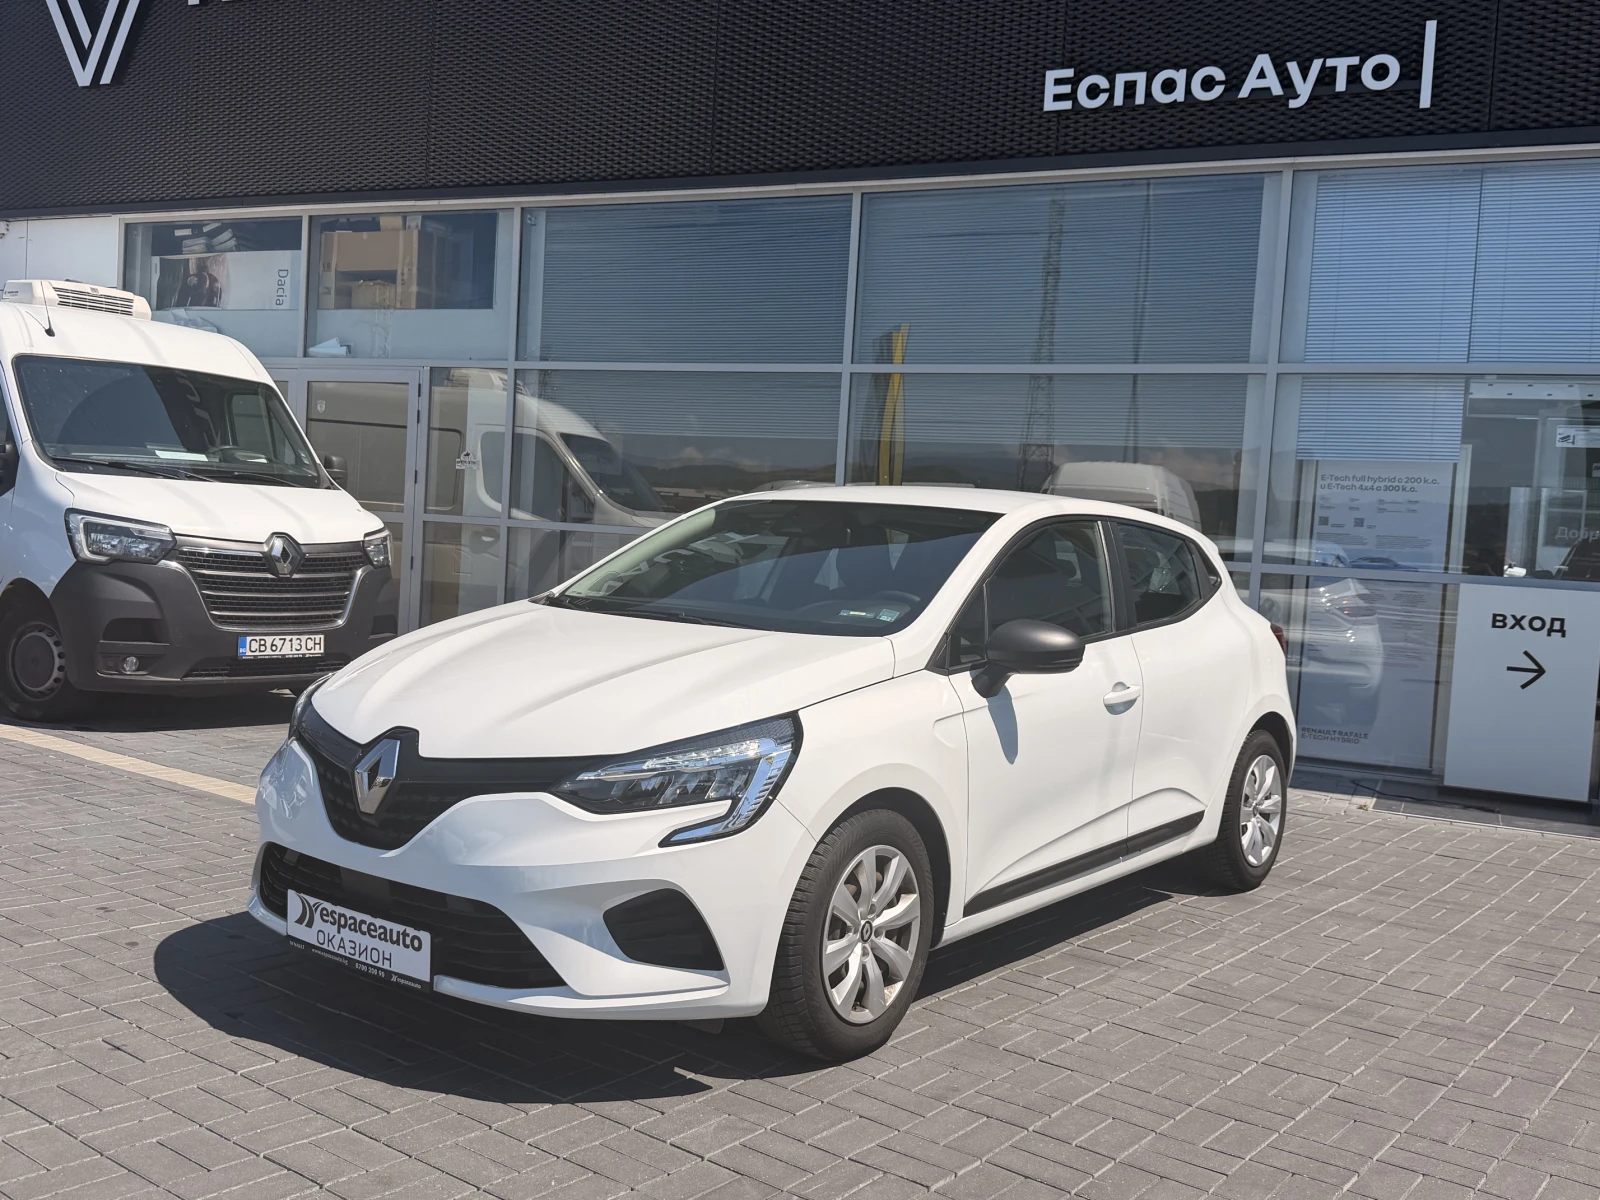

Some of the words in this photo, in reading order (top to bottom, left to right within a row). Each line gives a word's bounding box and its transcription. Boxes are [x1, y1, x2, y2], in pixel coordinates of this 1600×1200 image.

[1043, 63, 1226, 111] Еспас
[1238, 53, 1401, 109] Ауто
[275, 268, 289, 306] Dacia
[1321, 474, 1350, 482] E-Tech
[1352, 474, 1366, 483] full
[1367, 475, 1396, 484] hybrid
[1327, 483, 1357, 491] E-Tech
[1555, 526, 1600, 542] Добр
[270, 637, 302, 652] 6713
[1301, 727, 1337, 736] RENAULT
[1338, 730, 1368, 739] RAFALE
[1301, 733, 1329, 741] E-TECH
[1330, 736, 1360, 744] HYBRID
[320, 905, 423, 952] espaceauto
[316, 929, 393, 968] ОКАЗИОН
